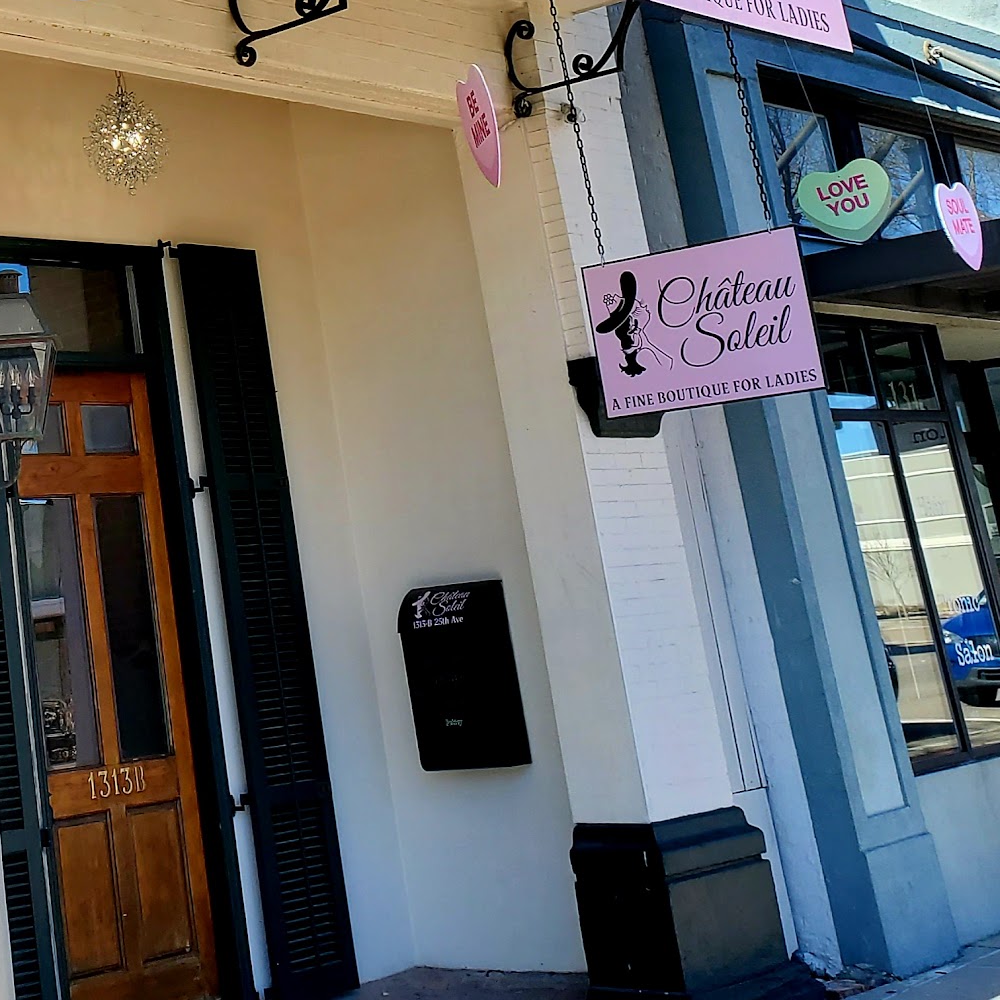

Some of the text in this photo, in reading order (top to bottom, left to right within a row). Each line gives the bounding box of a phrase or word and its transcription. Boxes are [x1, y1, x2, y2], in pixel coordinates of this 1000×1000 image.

[779, 2, 831, 34] LADIES
[466, 90, 480, 119] BE
[470, 113, 491, 149] MINE
[815, 173, 869, 202] LOVE
[826, 192, 871, 217] YOU
[946, 198, 970, 216] SOUL
[952, 218, 976, 236] MATE
[657, 270, 796, 328] Château
[680, 305, 792, 368] Soleil
[611, 368, 818, 411] A FINE BOUTIQUE FOR LADIES
[434, 617, 449, 626] 25th
[954, 639, 995, 667] Salon
[87, 765, 147, 800] 1313B
